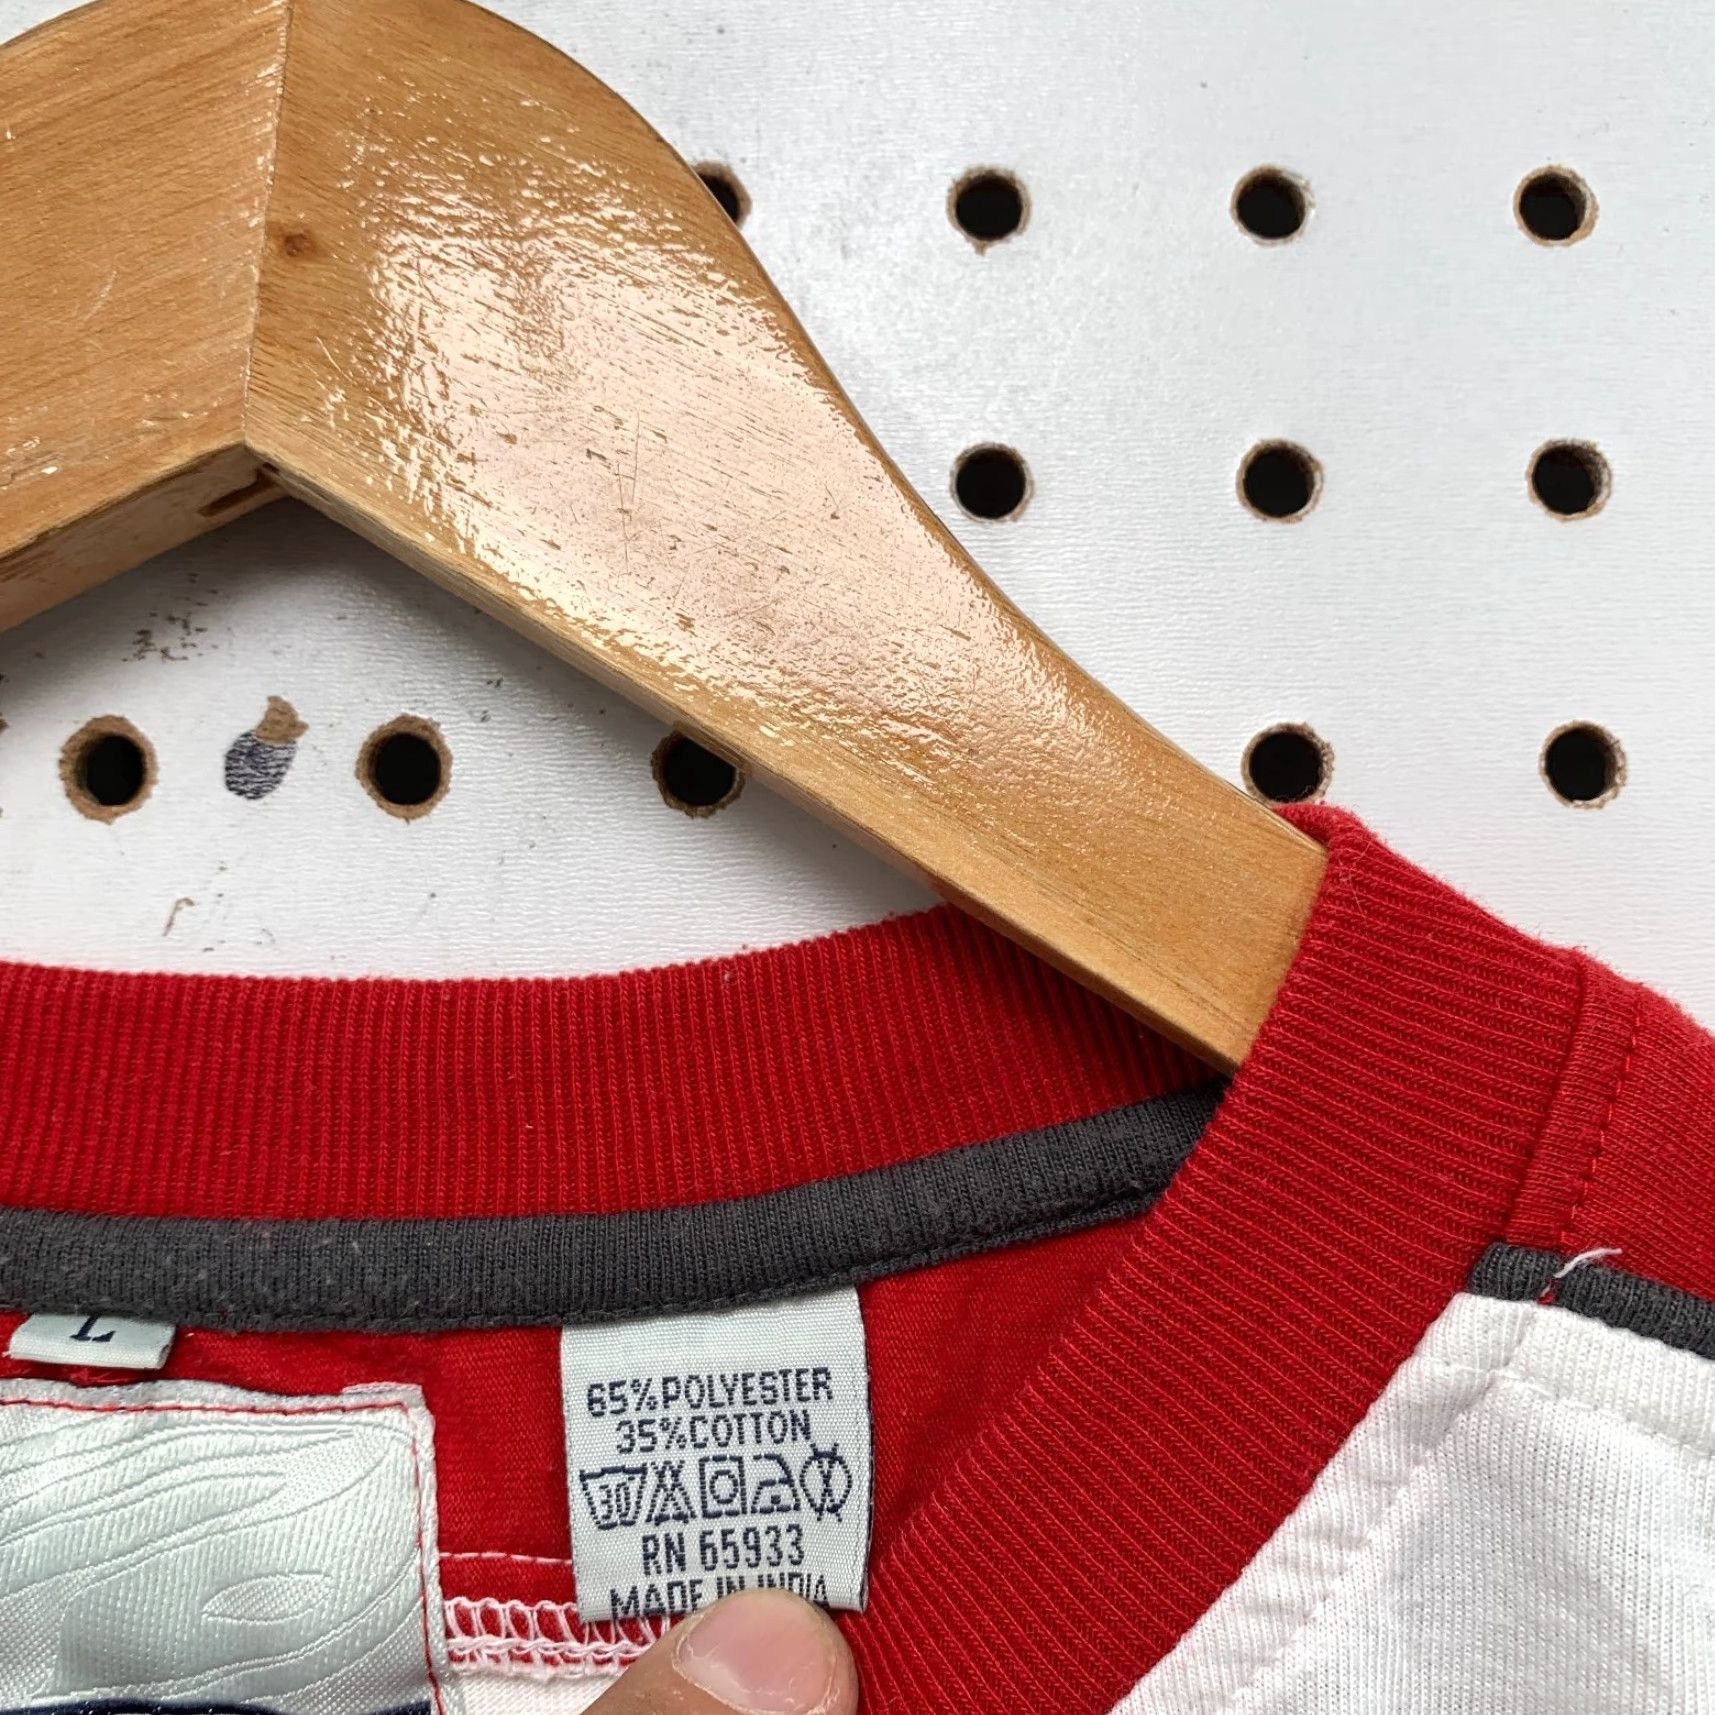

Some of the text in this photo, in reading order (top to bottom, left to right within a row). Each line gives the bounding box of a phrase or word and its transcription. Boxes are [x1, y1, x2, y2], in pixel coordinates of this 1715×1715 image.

[70, 1313, 116, 1342] L
[642, 1524, 805, 1576] RN 65933
[611, 1579, 703, 1620] MADE
